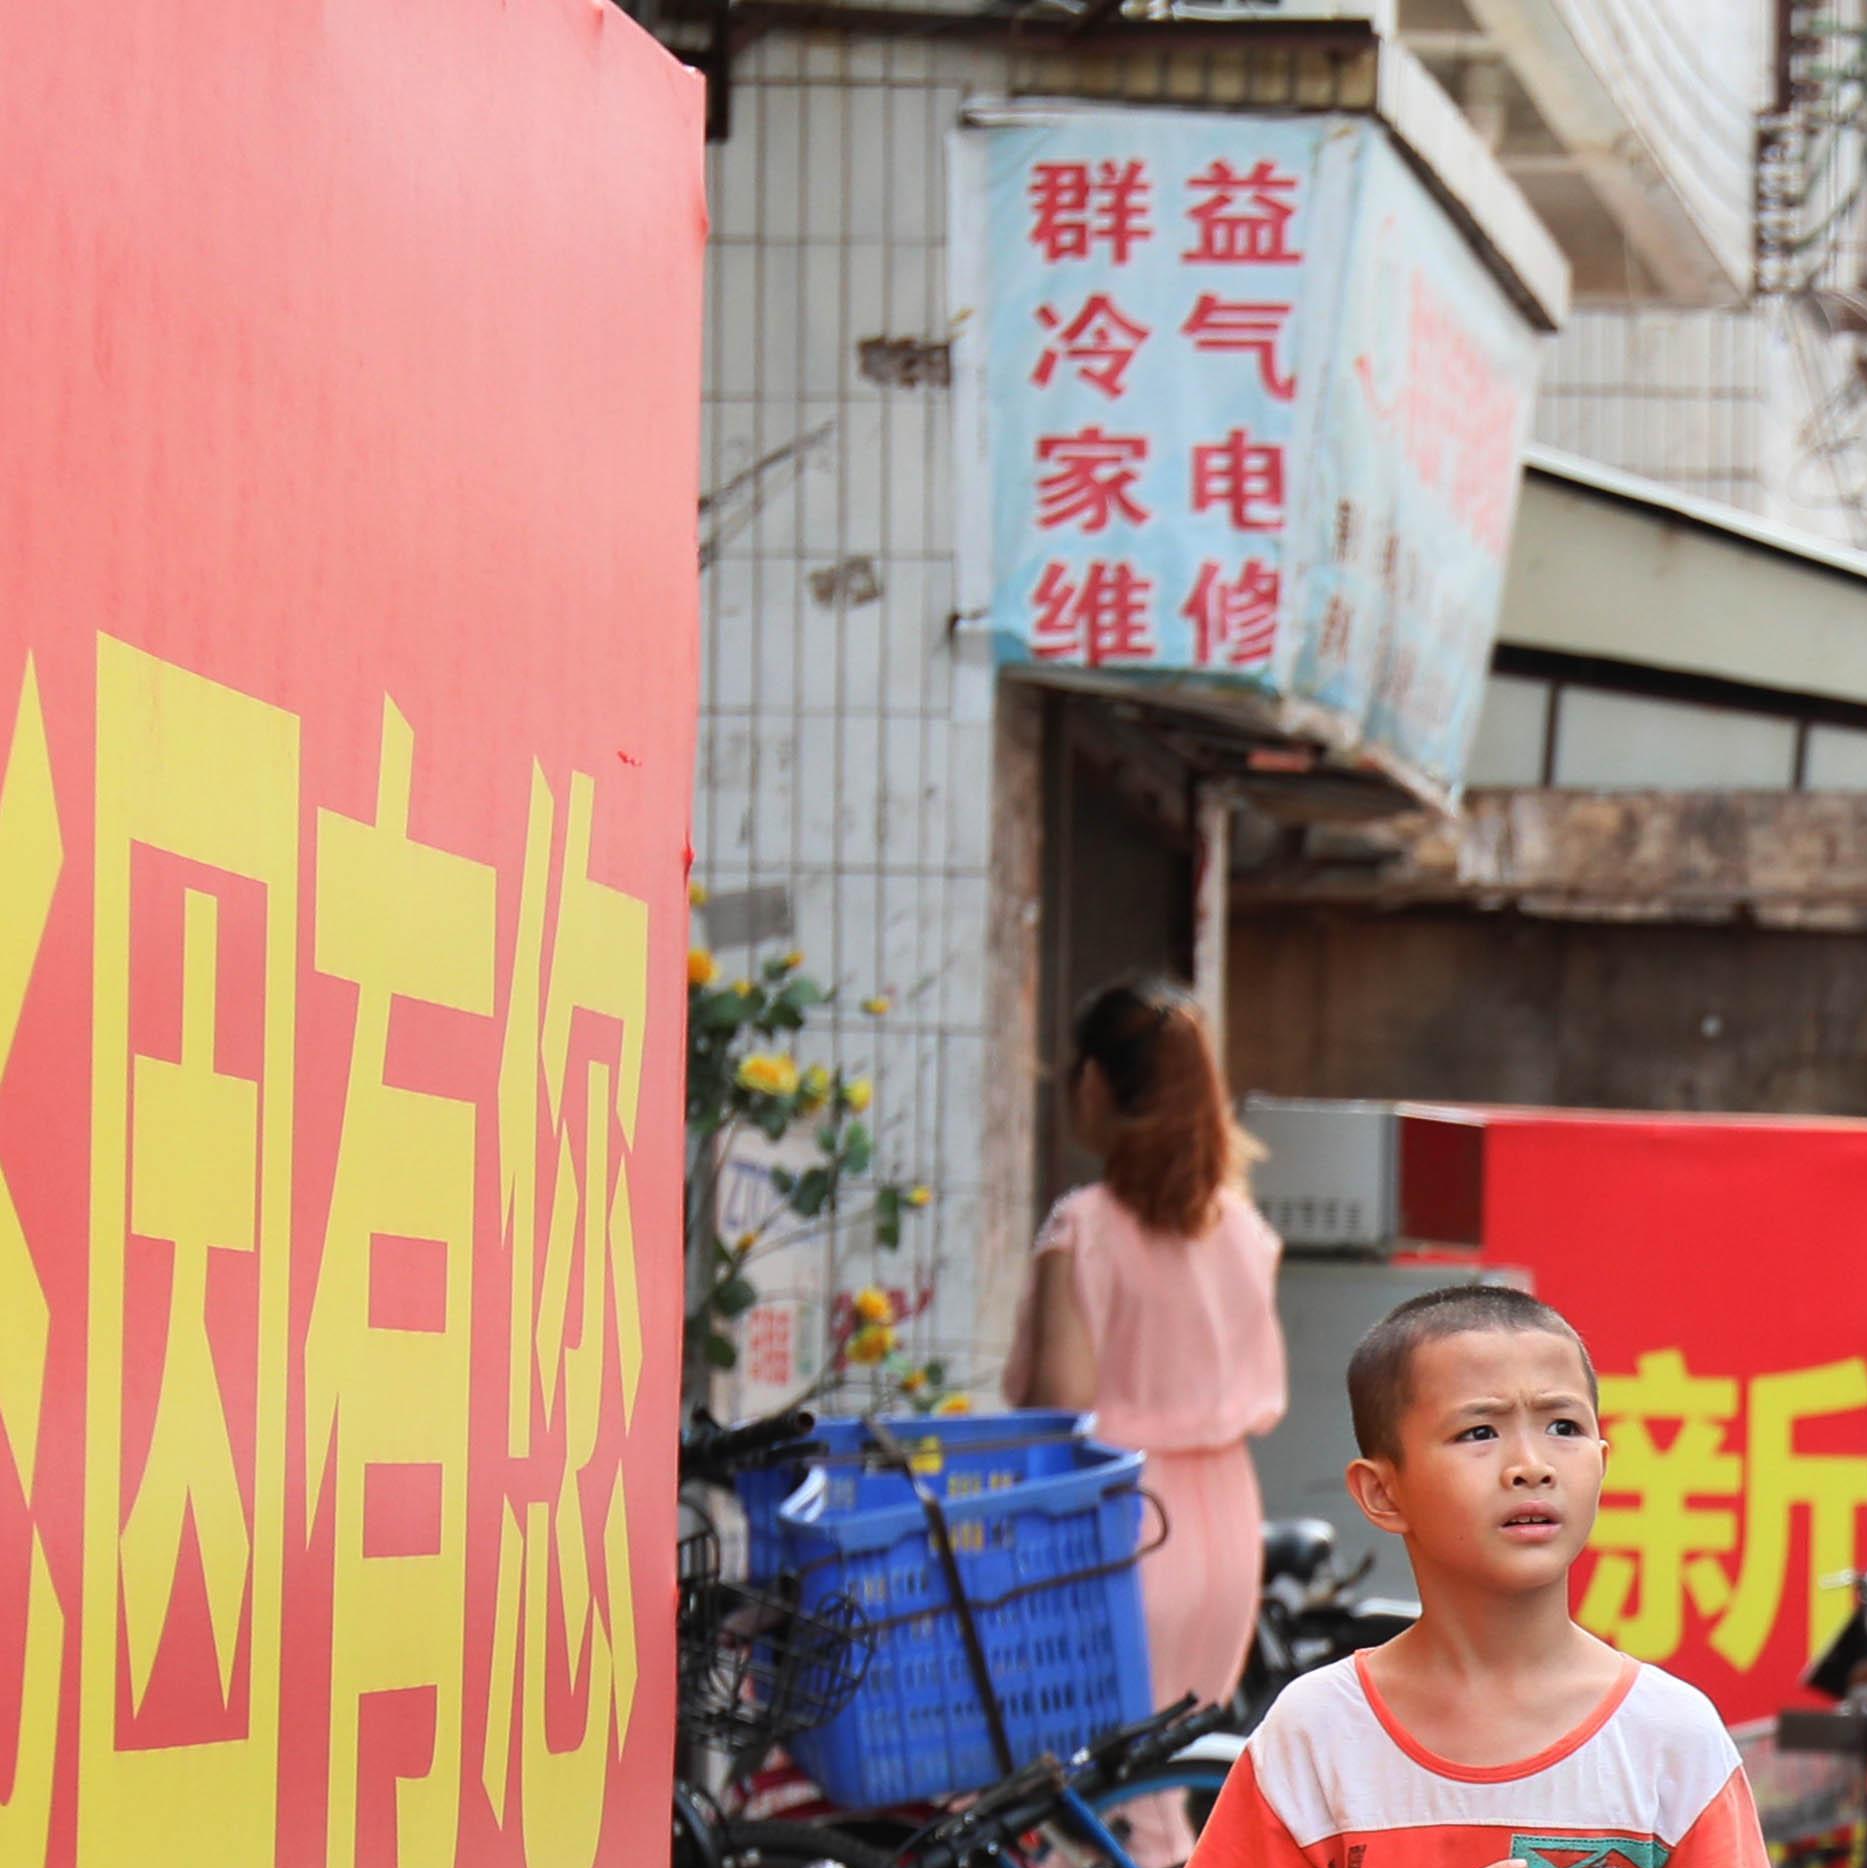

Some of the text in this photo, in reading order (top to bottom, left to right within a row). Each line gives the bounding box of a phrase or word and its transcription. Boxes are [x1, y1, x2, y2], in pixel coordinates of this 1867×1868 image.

[1028, 157, 1304, 268] 群益
[1029, 292, 1297, 403] 冷气
[1033, 427, 1287, 535] 家电
[1027, 559, 1284, 668] 维修
